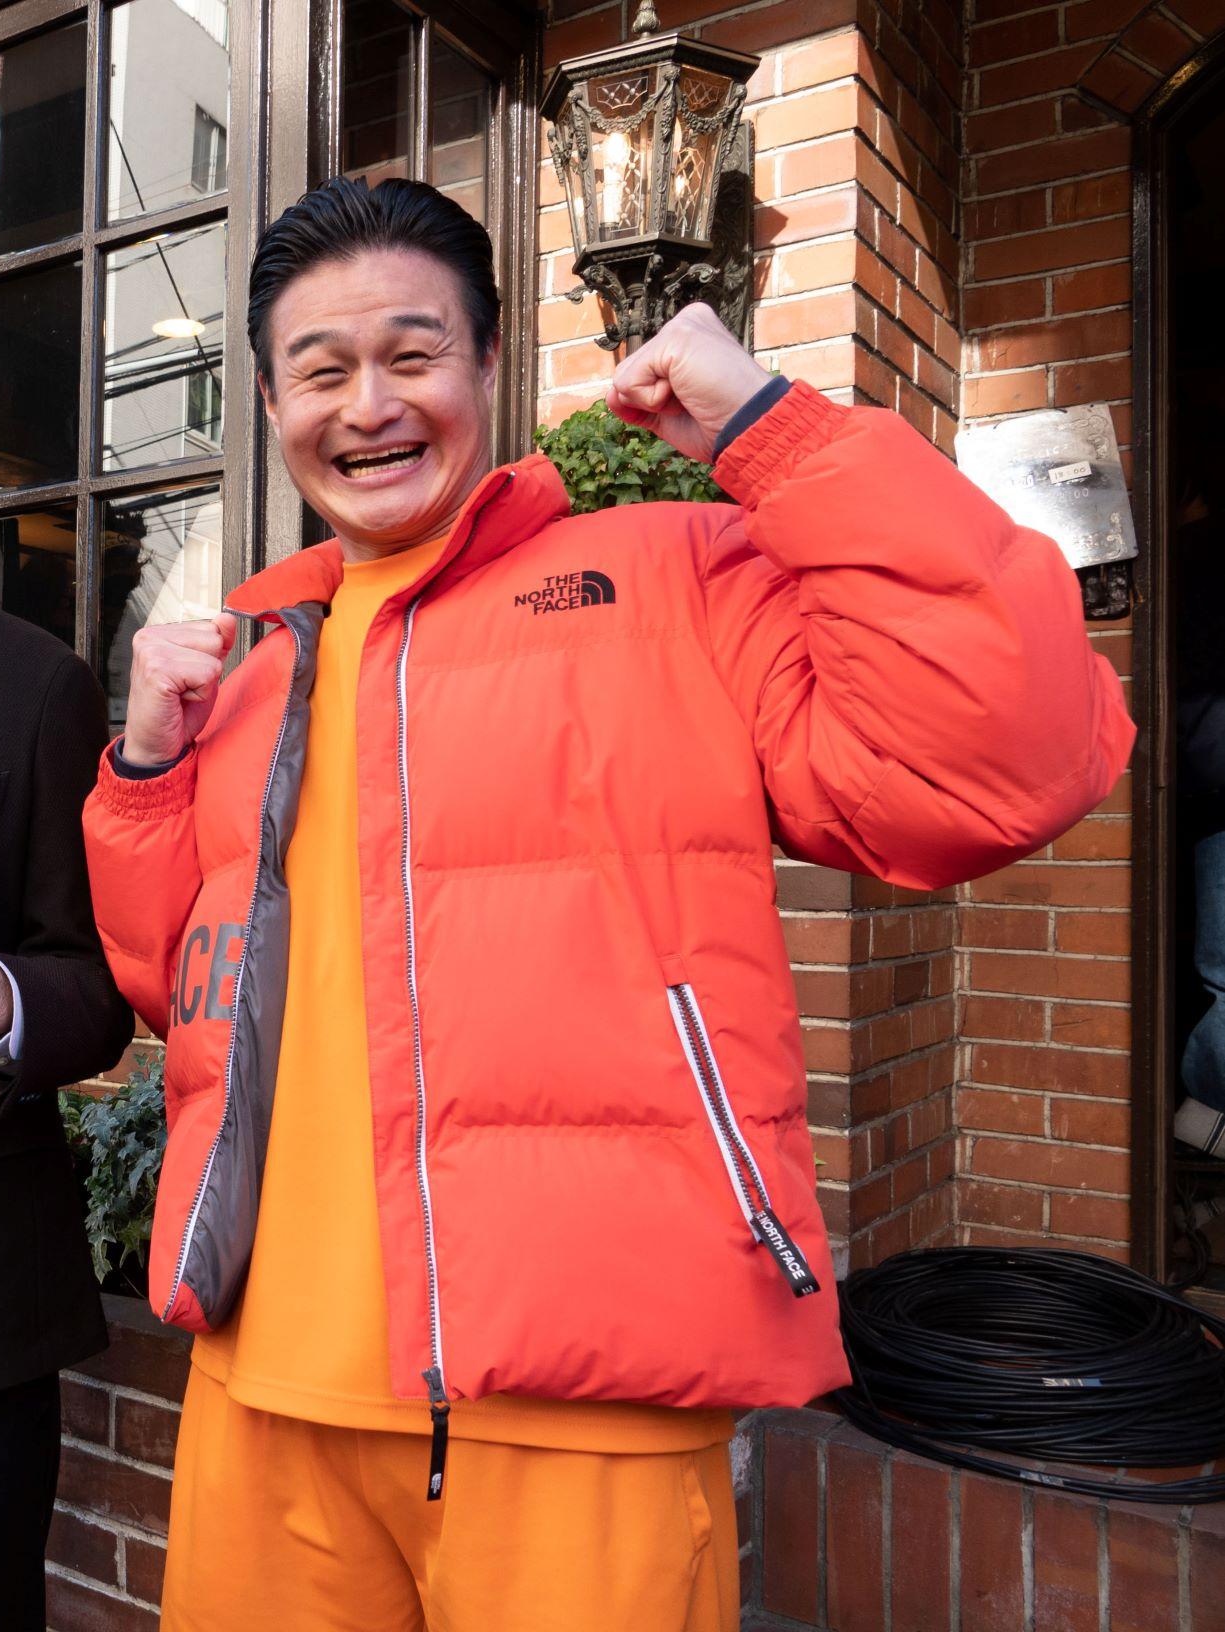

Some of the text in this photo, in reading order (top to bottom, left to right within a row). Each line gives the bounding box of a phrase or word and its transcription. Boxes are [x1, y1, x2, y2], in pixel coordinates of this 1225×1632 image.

[544, 572, 580, 587] THE
[514, 584, 580, 607] NORTH
[533, 596, 580, 615] FACE
[168, 923, 248, 1031] ACE
[759, 1216, 787, 1250] NORTH
[780, 1250, 806, 1280] FACE
